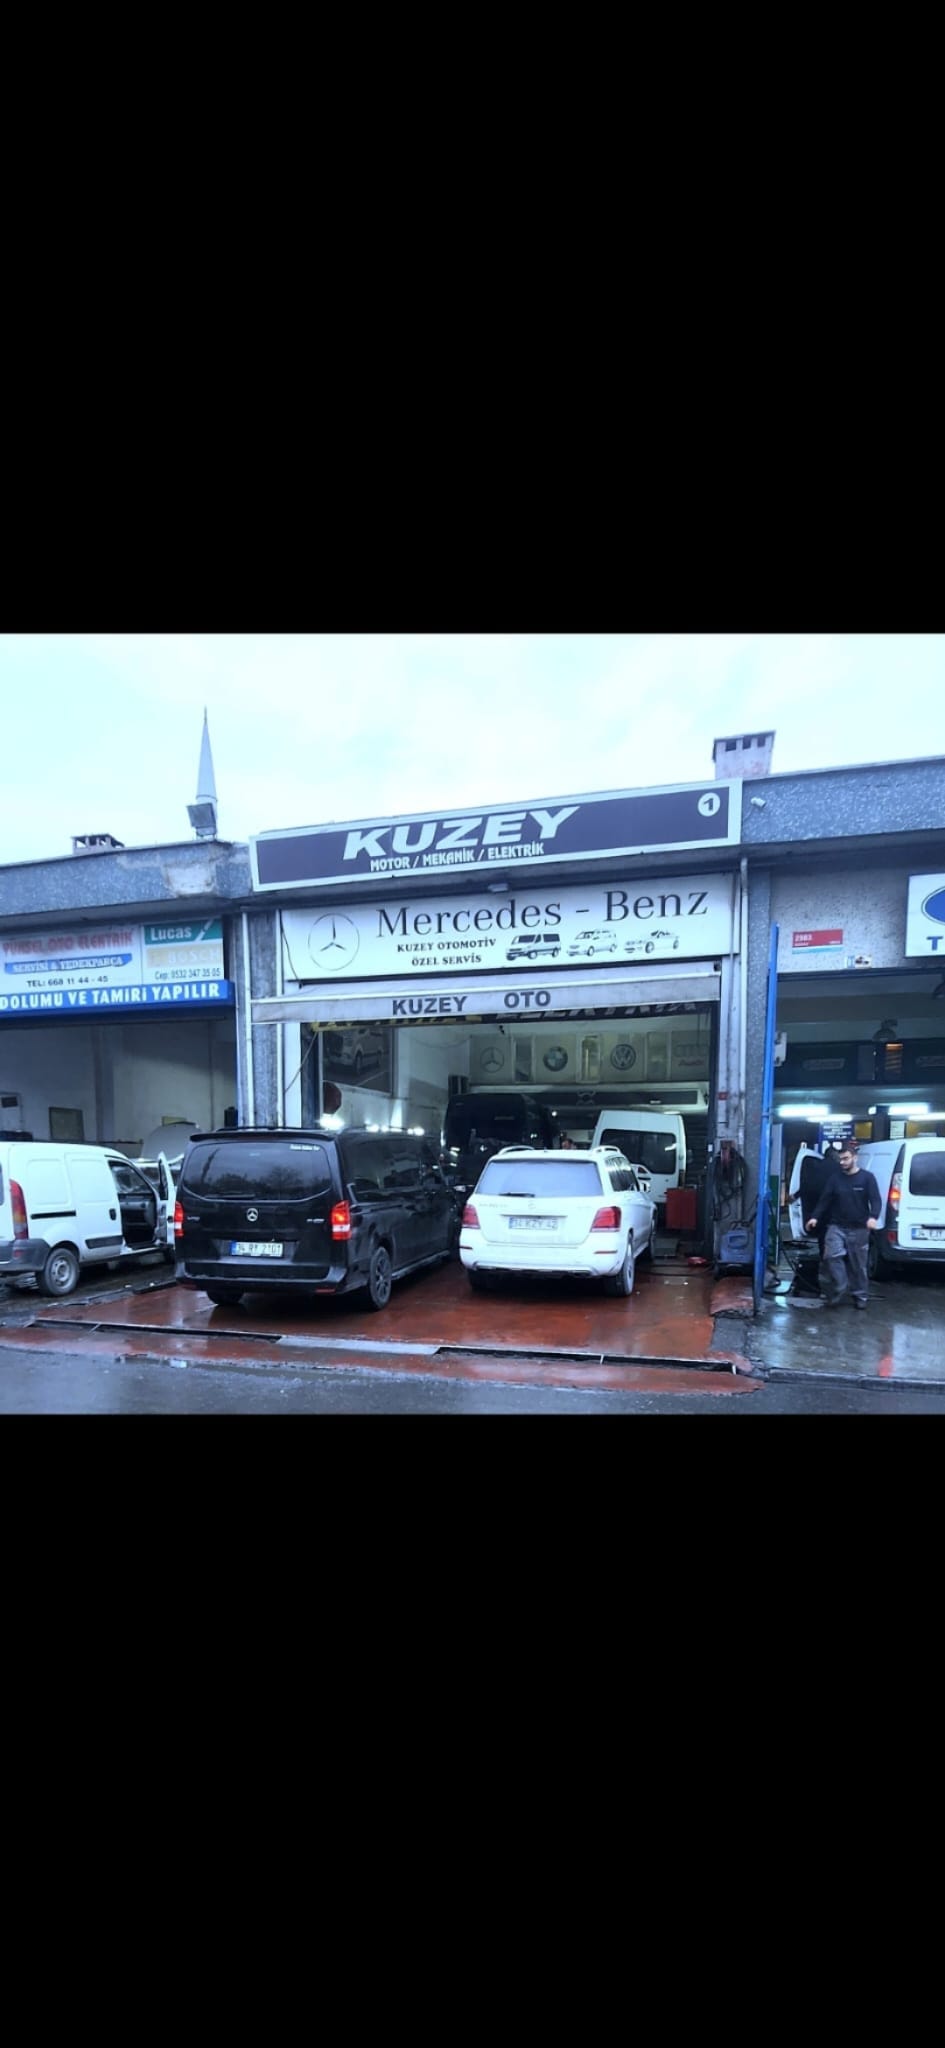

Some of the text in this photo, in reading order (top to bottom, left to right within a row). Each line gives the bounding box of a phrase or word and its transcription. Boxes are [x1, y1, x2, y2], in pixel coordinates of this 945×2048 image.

[703, 796, 715, 814] 1
[343, 806, 580, 860] KUZEY
[370, 855, 411, 873] MOTOR
[422, 849, 475, 868] MEKANİK
[488, 840, 545, 860] ELEKTRİK
[376, 897, 563, 939] Mercedes
[604, 889, 710, 923] Benz
[151, 926, 192, 941] Lucas
[397, 937, 497, 953] KUZEY OTOMOTİV
[168, 948, 219, 964] BOSCH
[411, 953, 483, 967] ÖZEL SERVİS
[27, 979, 45, 988] TEL:
[78, 976, 89, 984] 44
[0, 981, 220, 1011] DOLUMU VE TAMİRİ YAPILIR
[391, 990, 552, 1016] KUZEY OTO
